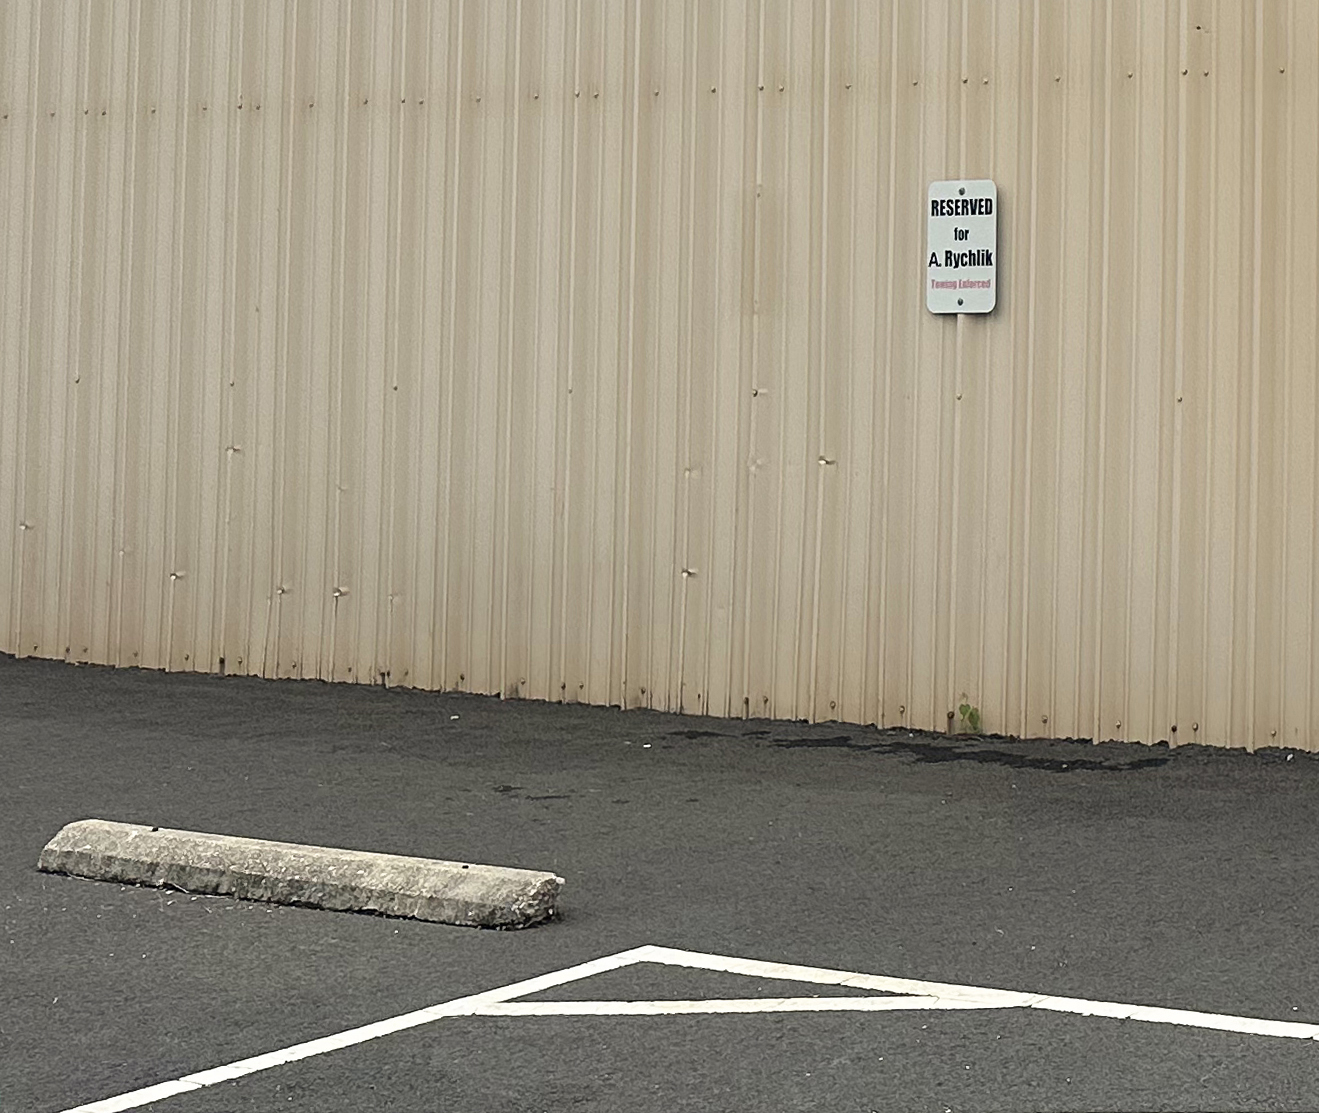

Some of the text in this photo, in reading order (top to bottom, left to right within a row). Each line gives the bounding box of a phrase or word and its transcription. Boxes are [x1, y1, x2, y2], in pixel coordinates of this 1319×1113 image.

[930, 198, 993, 217] RESERVED
[953, 227, 970, 241] for
[928, 249, 993, 269] A. Rychlik
